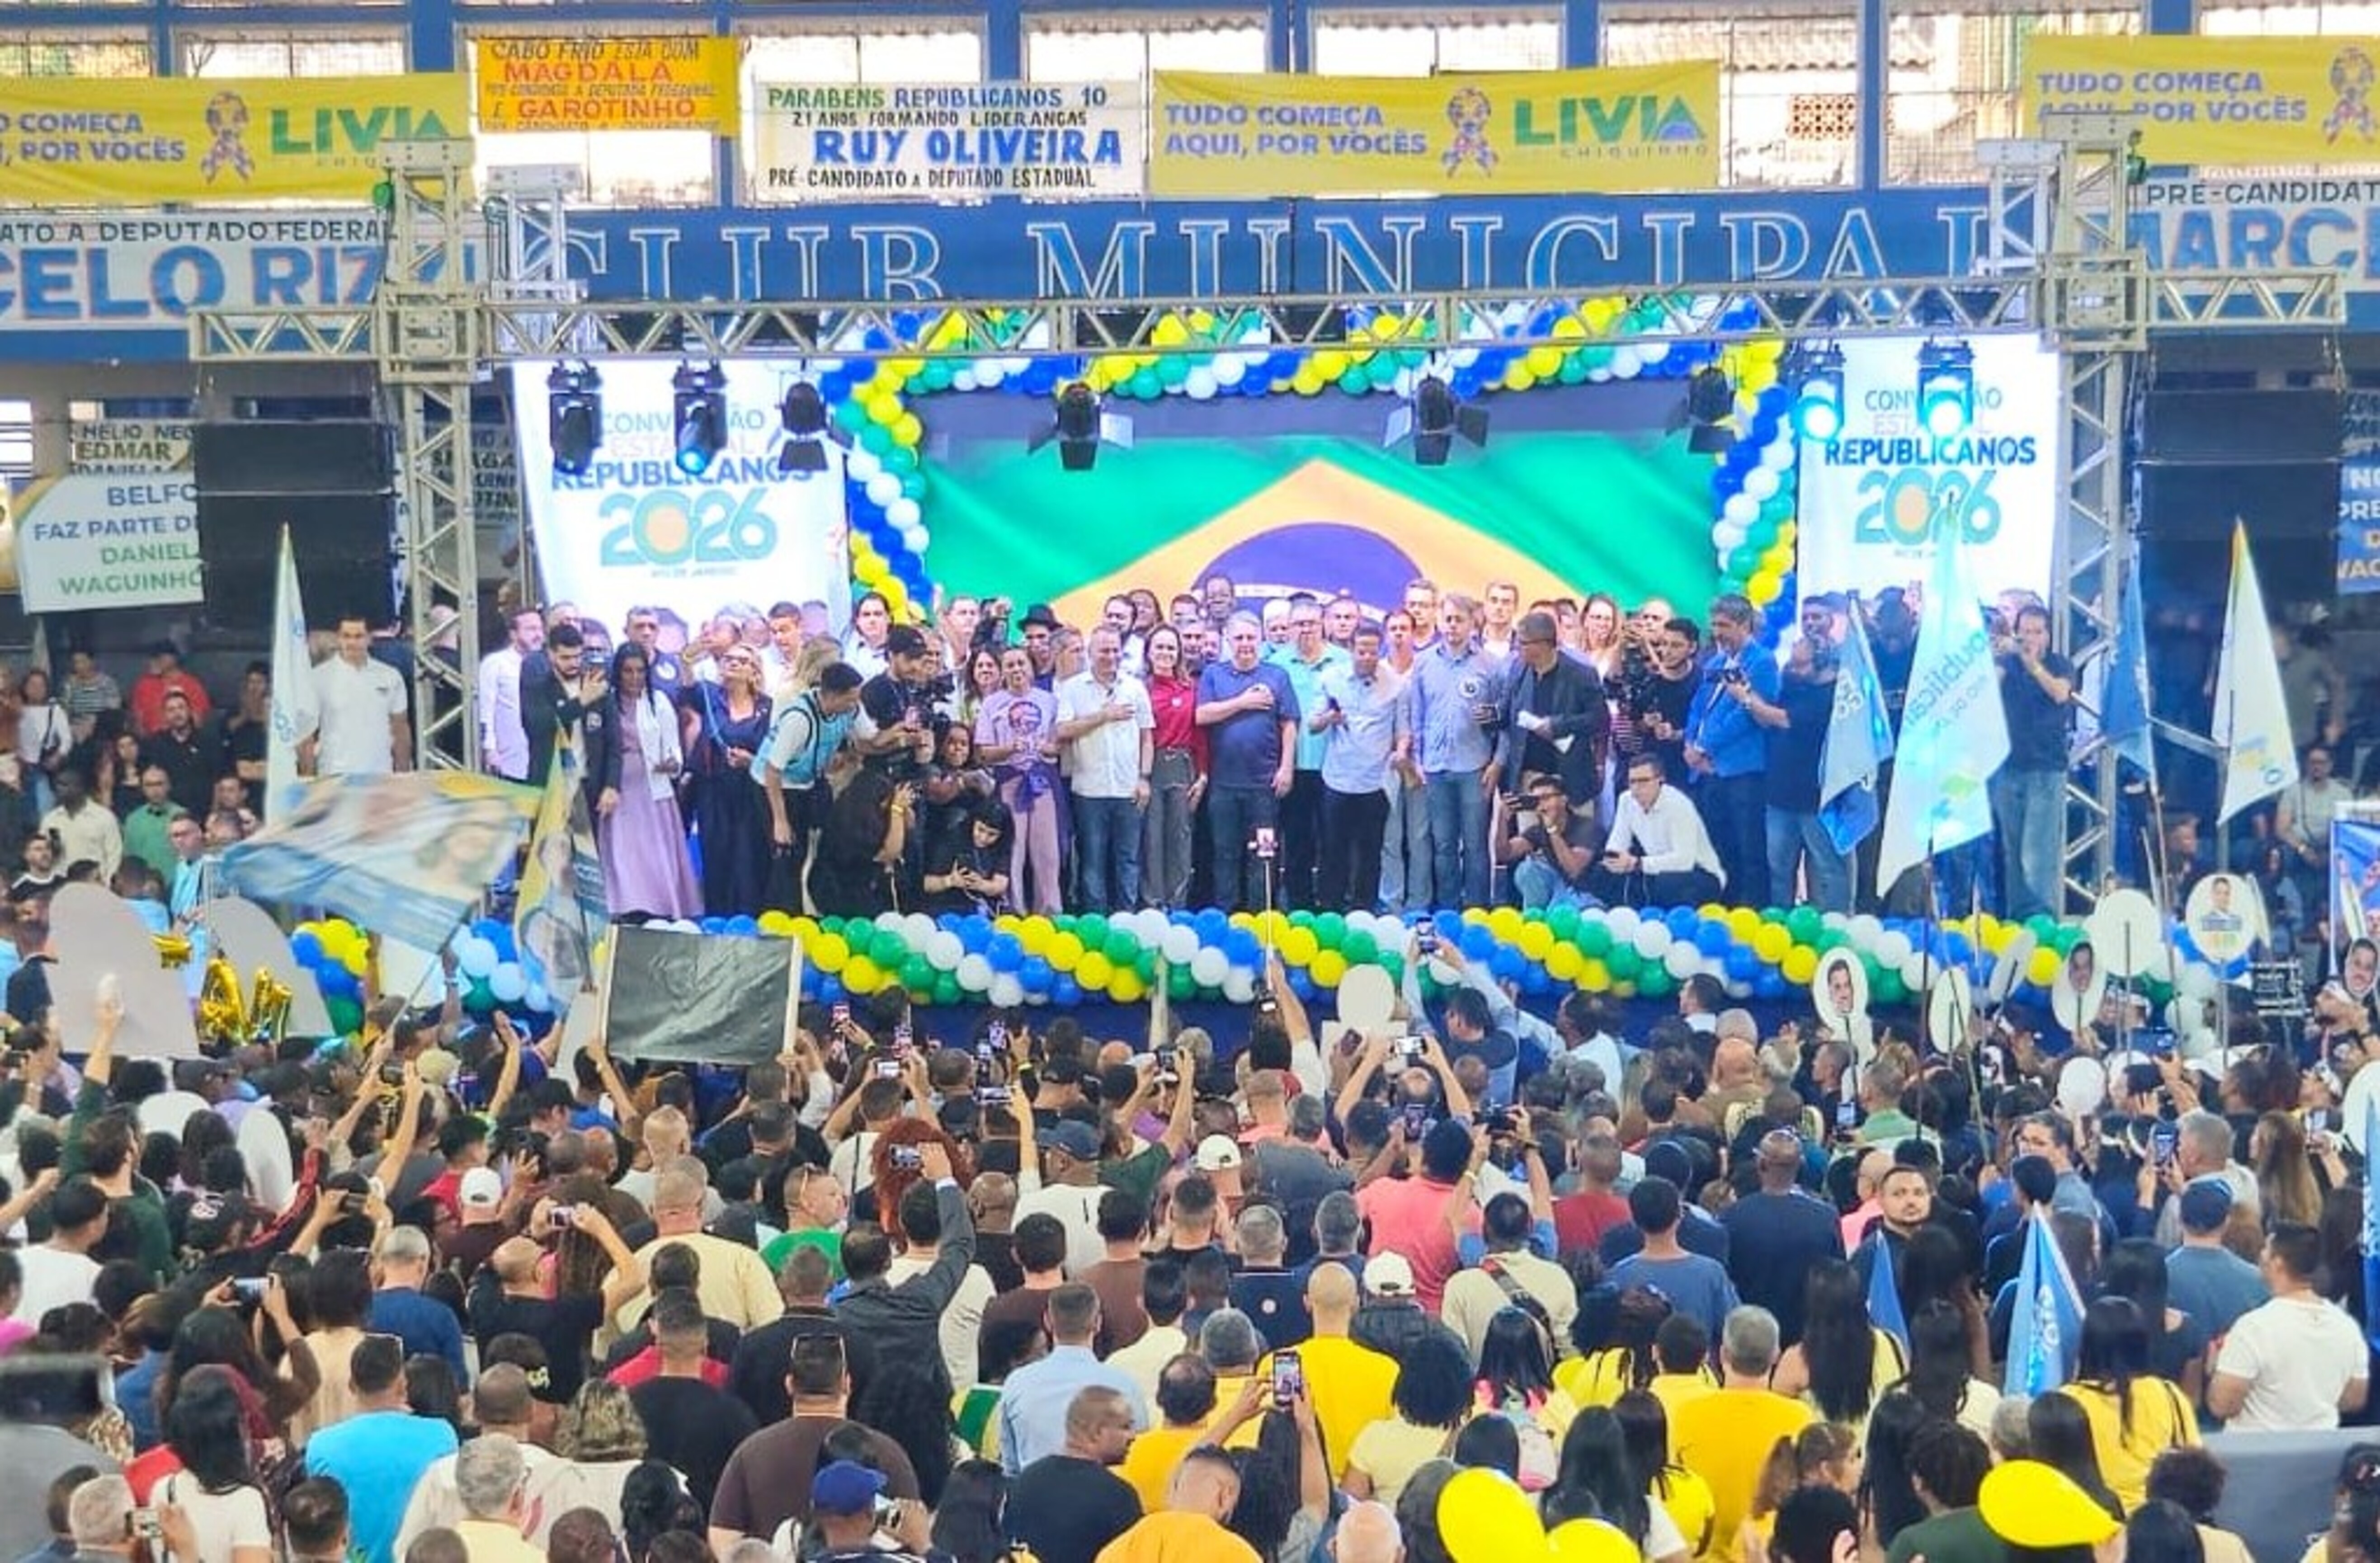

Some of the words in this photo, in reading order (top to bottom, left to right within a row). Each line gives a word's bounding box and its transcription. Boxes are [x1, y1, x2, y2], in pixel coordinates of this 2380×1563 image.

[504, 62, 673, 82] MAGDALA
[2036, 72, 2123, 93] TUDO
[2133, 72, 2263, 97] COMEÇA
[518, 98, 696, 119] GAROTINHO
[895, 88, 1061, 108] REPUBLICANOS
[1081, 86, 1107, 107] 10
[2133, 101, 2196, 122] POR
[2207, 95, 2308, 122] VOCÊS
[19, 113, 144, 137] COMEÇA
[793, 112, 811, 127] 21
[819, 112, 858, 127] ANOS
[869, 111, 958, 127] FORMANDO
[1165, 104, 1248, 125] TUDO
[1258, 105, 1383, 131] COMEÇA
[1515, 96, 1706, 146] LIVIA
[272, 107, 450, 155] LIVIA
[1165, 133, 1248, 157] AQUI,
[1257, 133, 1320, 155] POR
[1329, 129, 1428, 155] VOCÊS
[20, 141, 81, 162] POR
[89, 136, 186, 161] VOCÊS
[815, 129, 910, 164] RUY
[927, 129, 1123, 165] OLIVEIRA
[1561, 145, 1708, 159] CHIQUINHO
[808, 168, 907, 188] CANDIDATO
[928, 167, 1003, 188] DEPUTADO
[1012, 167, 1096, 188] ESTADUAL
[67, 222, 85, 242] A
[99, 221, 268, 242] DEPUTADO
[0, 245, 226, 320] ELO
[75, 441, 172, 461] EDMAR
[1824, 436, 2037, 466] REPUBLICANOS
[1853, 467, 2002, 546] 2026
[33, 521, 82, 541] FAZ
[87, 516, 167, 537] PARTE
[174, 515, 199, 532] D
[599, 487, 778, 568] 2026
